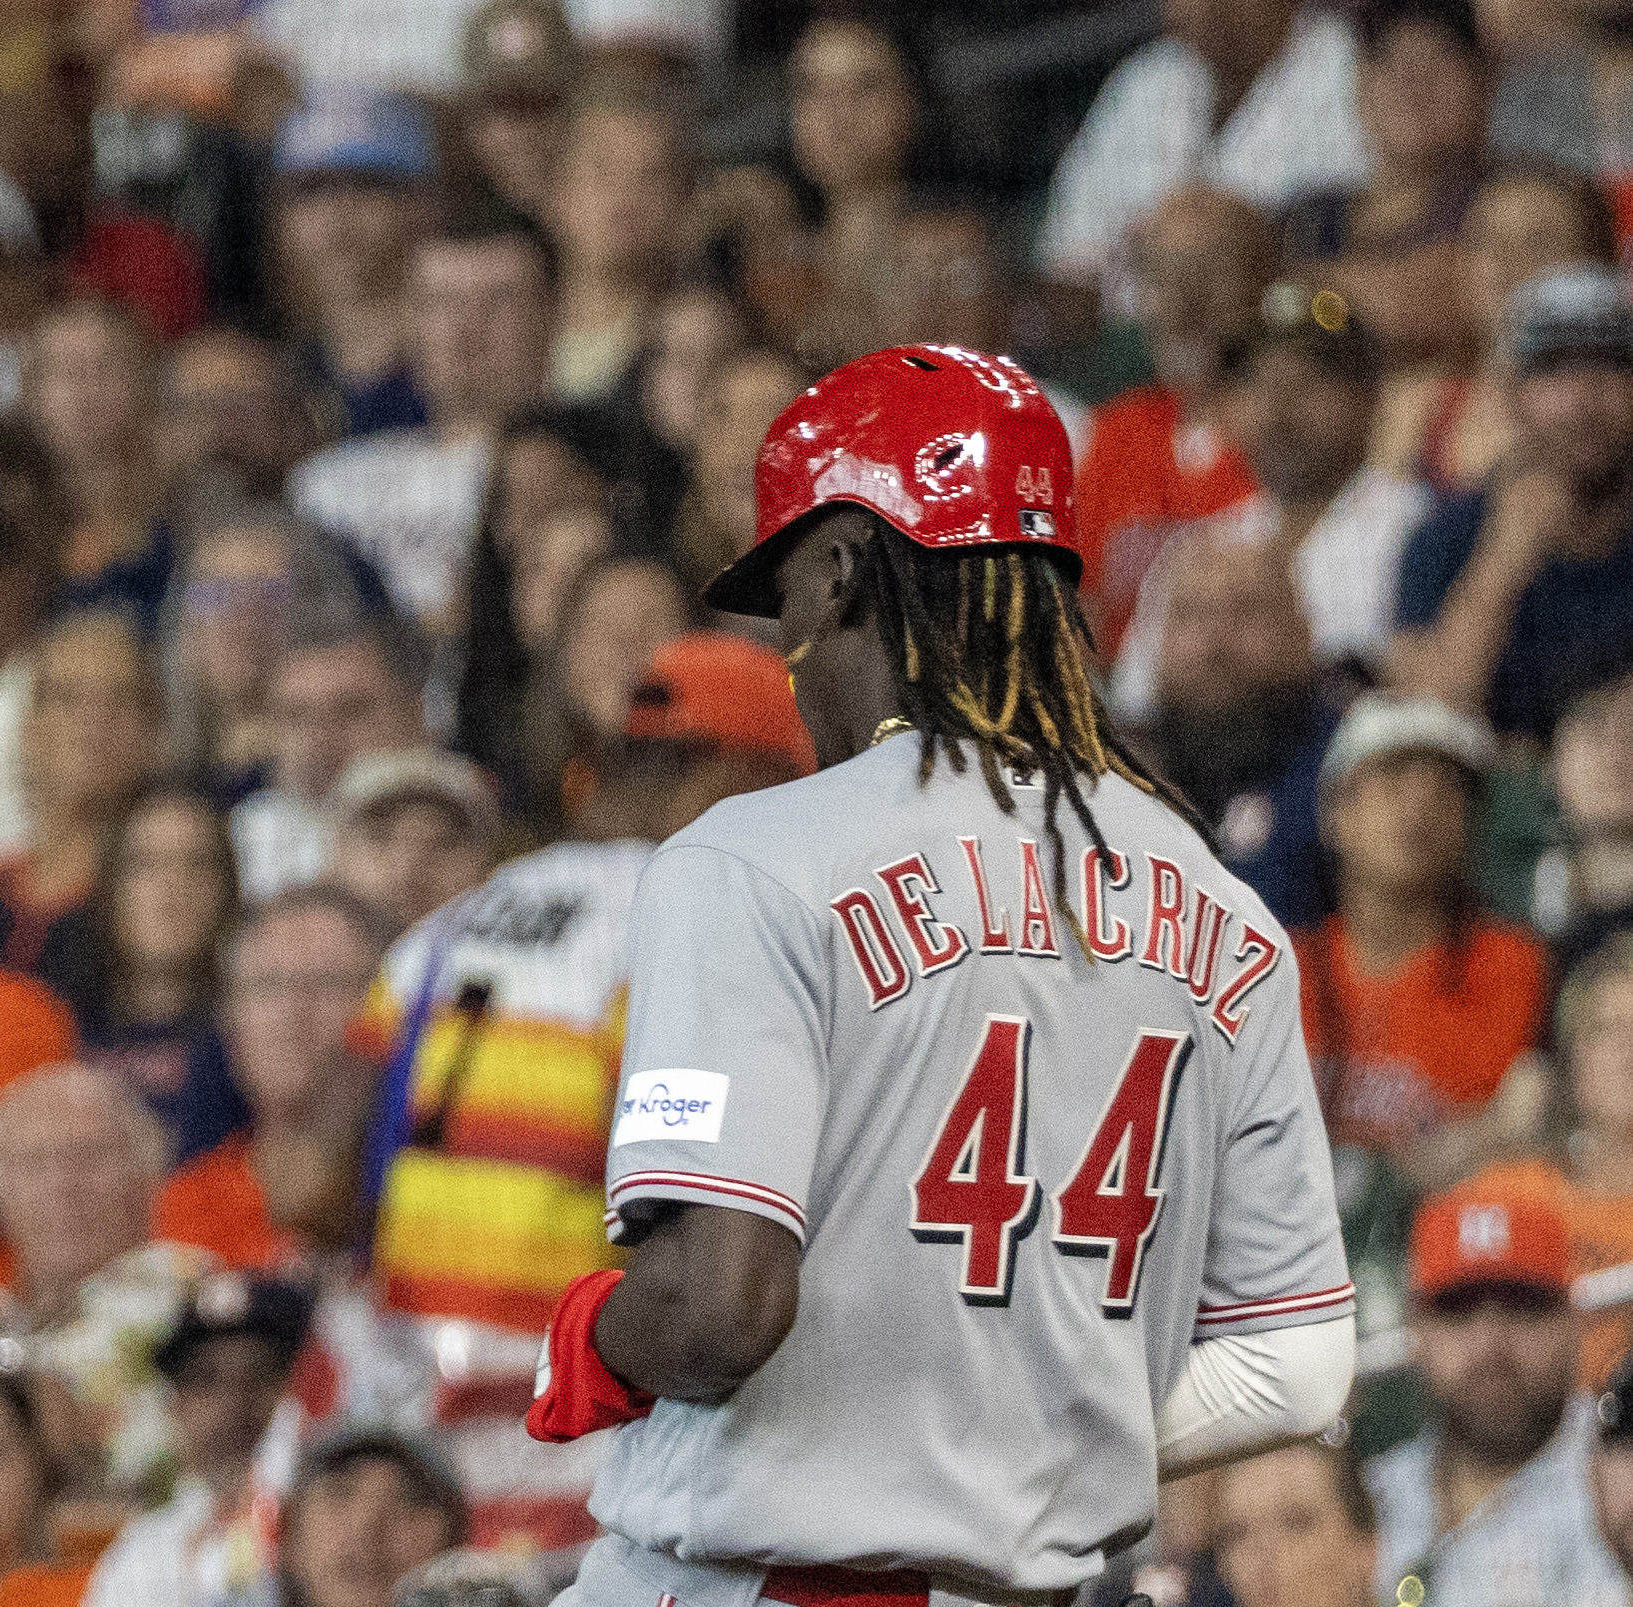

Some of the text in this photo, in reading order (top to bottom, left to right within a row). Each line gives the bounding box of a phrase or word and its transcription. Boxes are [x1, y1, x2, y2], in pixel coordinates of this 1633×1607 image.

[1015, 464, 1054, 505] 44
[830, 835, 1282, 1046] DE LA CRUZ
[908, 1011, 1195, 1318] 44
